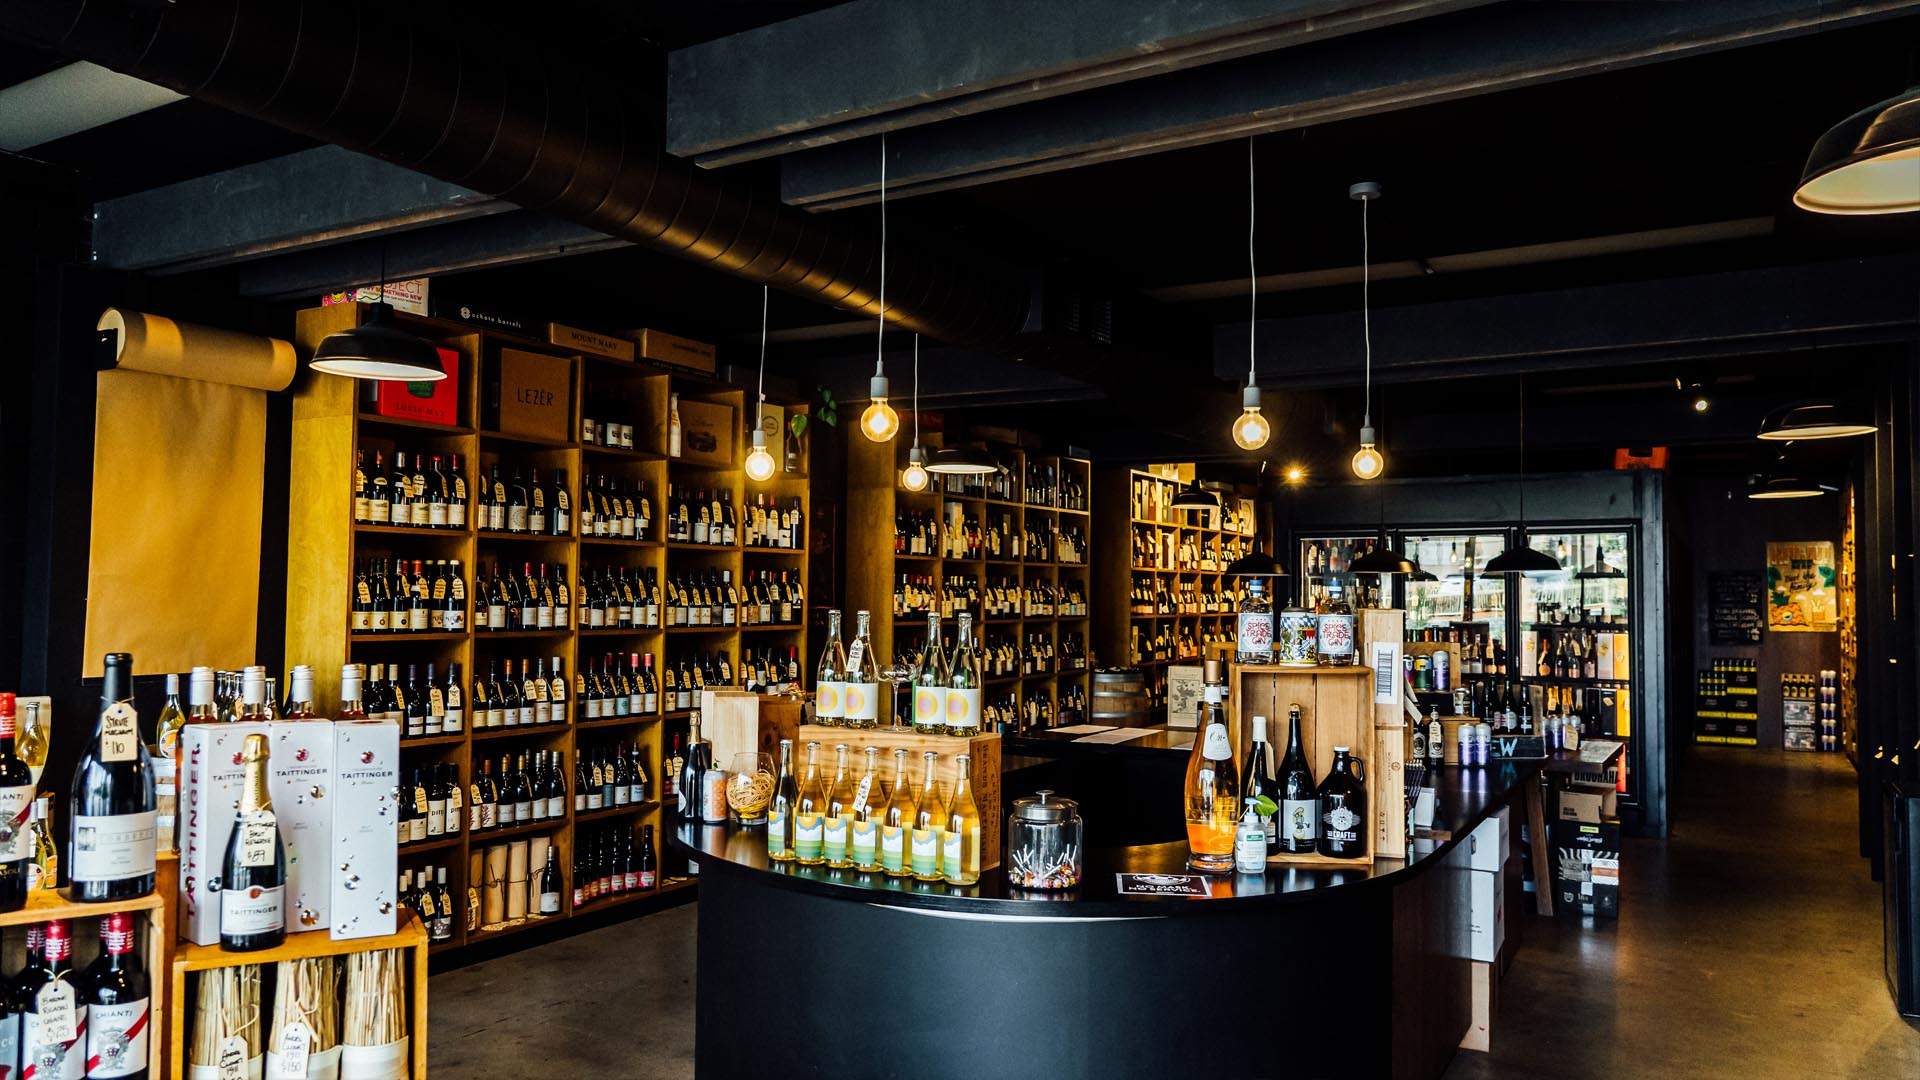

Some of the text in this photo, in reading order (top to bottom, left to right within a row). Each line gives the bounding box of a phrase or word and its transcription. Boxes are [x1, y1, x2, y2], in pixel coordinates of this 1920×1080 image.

[571, 331, 597, 345] MOUNT
[212, 773, 246, 781] TAITTIN
[276, 768, 328, 777] TAITTINGER
[341, 771, 394, 779] TAITTINGER
[186, 743, 201, 920] TAITTINGER
[230, 905, 278, 915] TAITTINGER
[95, 1010, 133, 1019] CHIANTI
